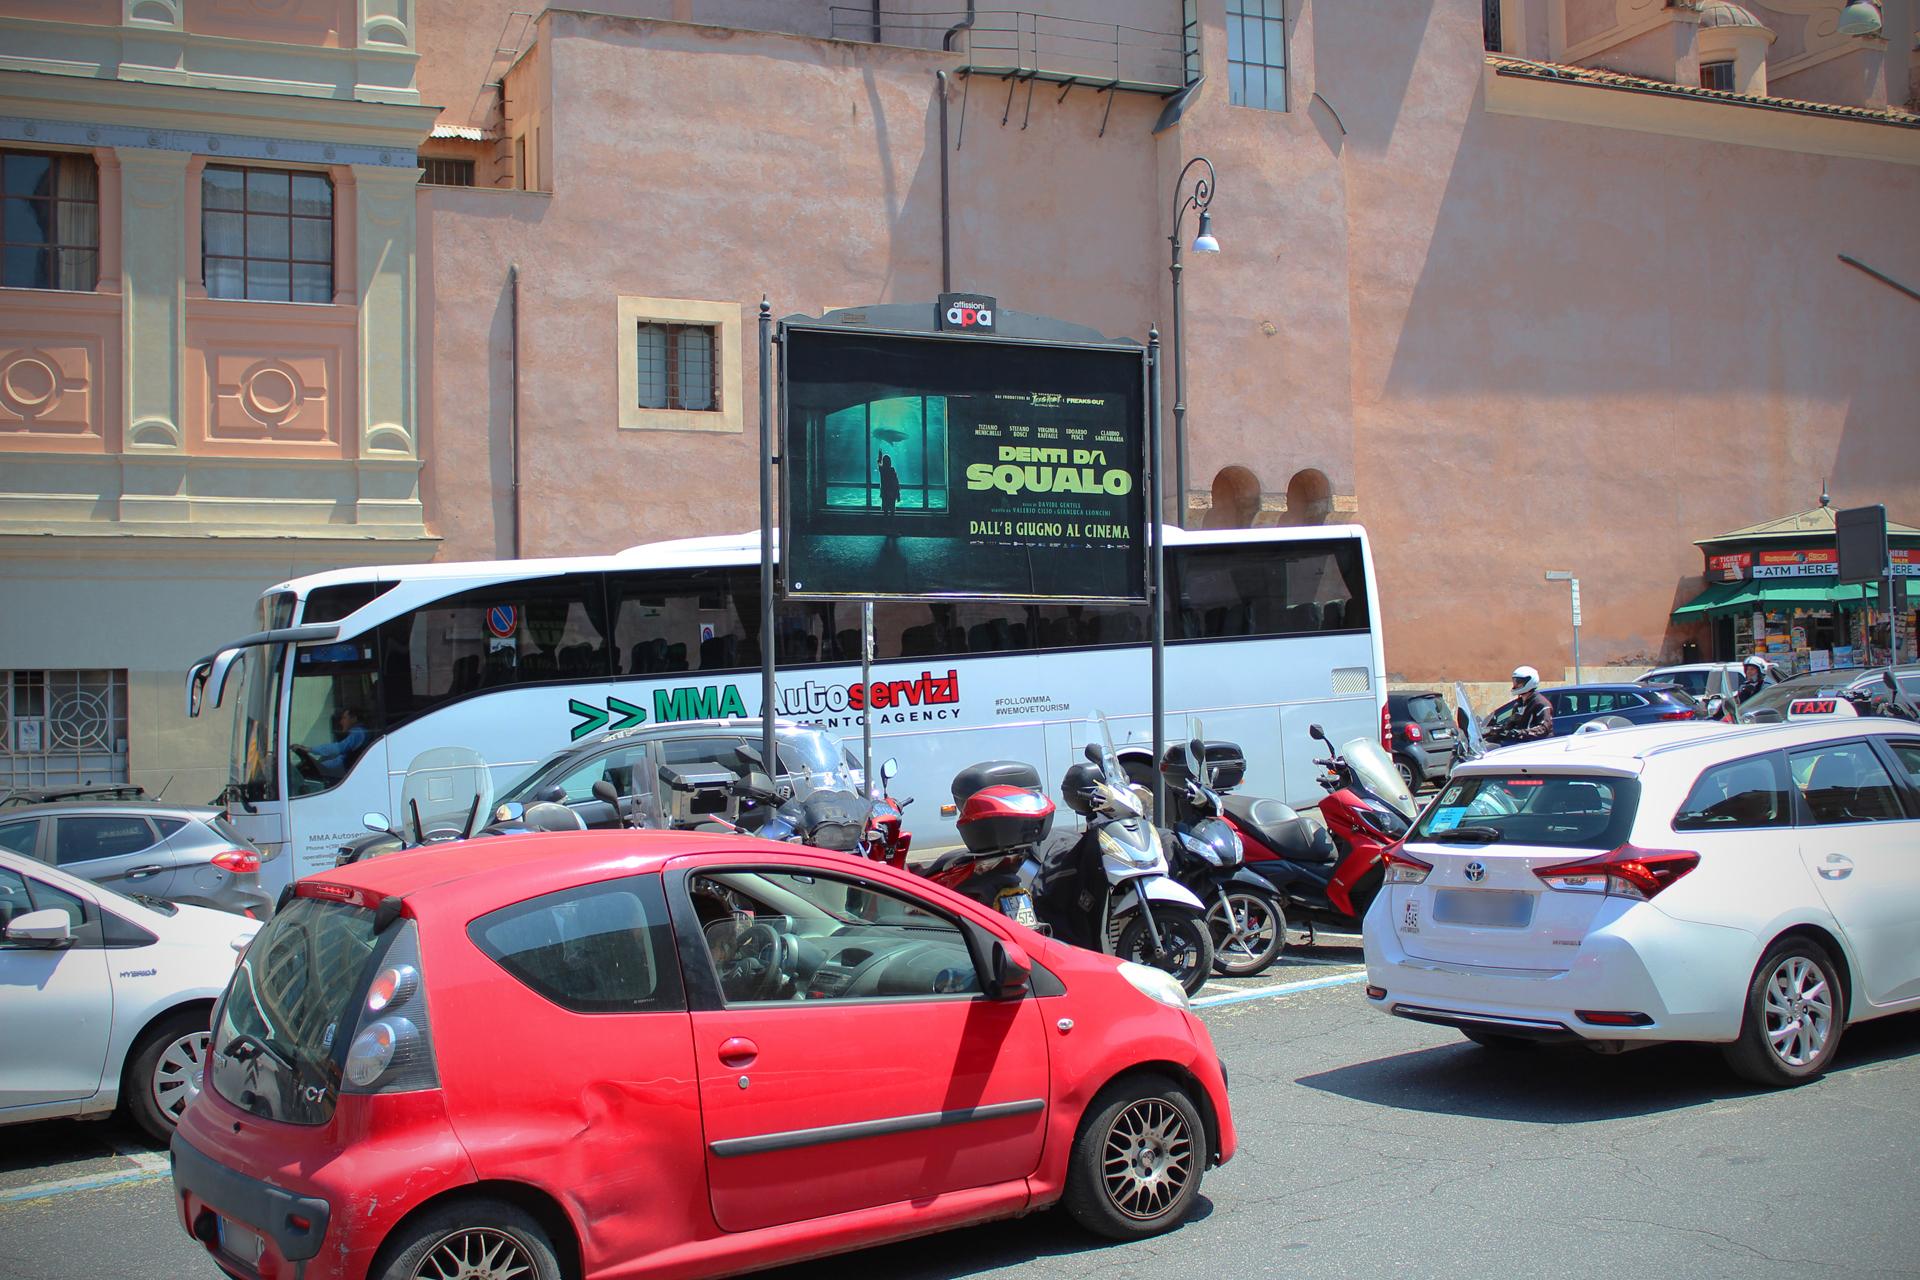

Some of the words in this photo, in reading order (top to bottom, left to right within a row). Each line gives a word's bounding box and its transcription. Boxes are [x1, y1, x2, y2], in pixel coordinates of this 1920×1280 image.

[953, 301, 985, 309] affissioni
[947, 308, 991, 327] apa
[999, 446, 1067, 464] DENTI
[1073, 449, 1107, 465] DA
[966, 463, 1132, 496] SQUALO
[969, 521, 1012, 536] DALL'8
[1016, 522, 1062, 537] GIUGNO
[1066, 523, 1080, 538] AL
[1085, 524, 1130, 539] CINEMA
[1764, 567, 1791, 576] ATM
[1797, 563, 1833, 575] HERE
[653, 685, 748, 723] MMA
[759, 669, 960, 717] Autoservizi
[995, 696, 1051, 706] #FOLLOWMMA
[996, 703, 1070, 715] #WEMOVETOURISM
[1794, 701, 1835, 713] TAXI
[881, 708, 960, 724] AGENCY
[309, 834, 331, 842] MMA
[332, 832, 363, 841] Autoser
[306, 1086, 327, 1103] C1
